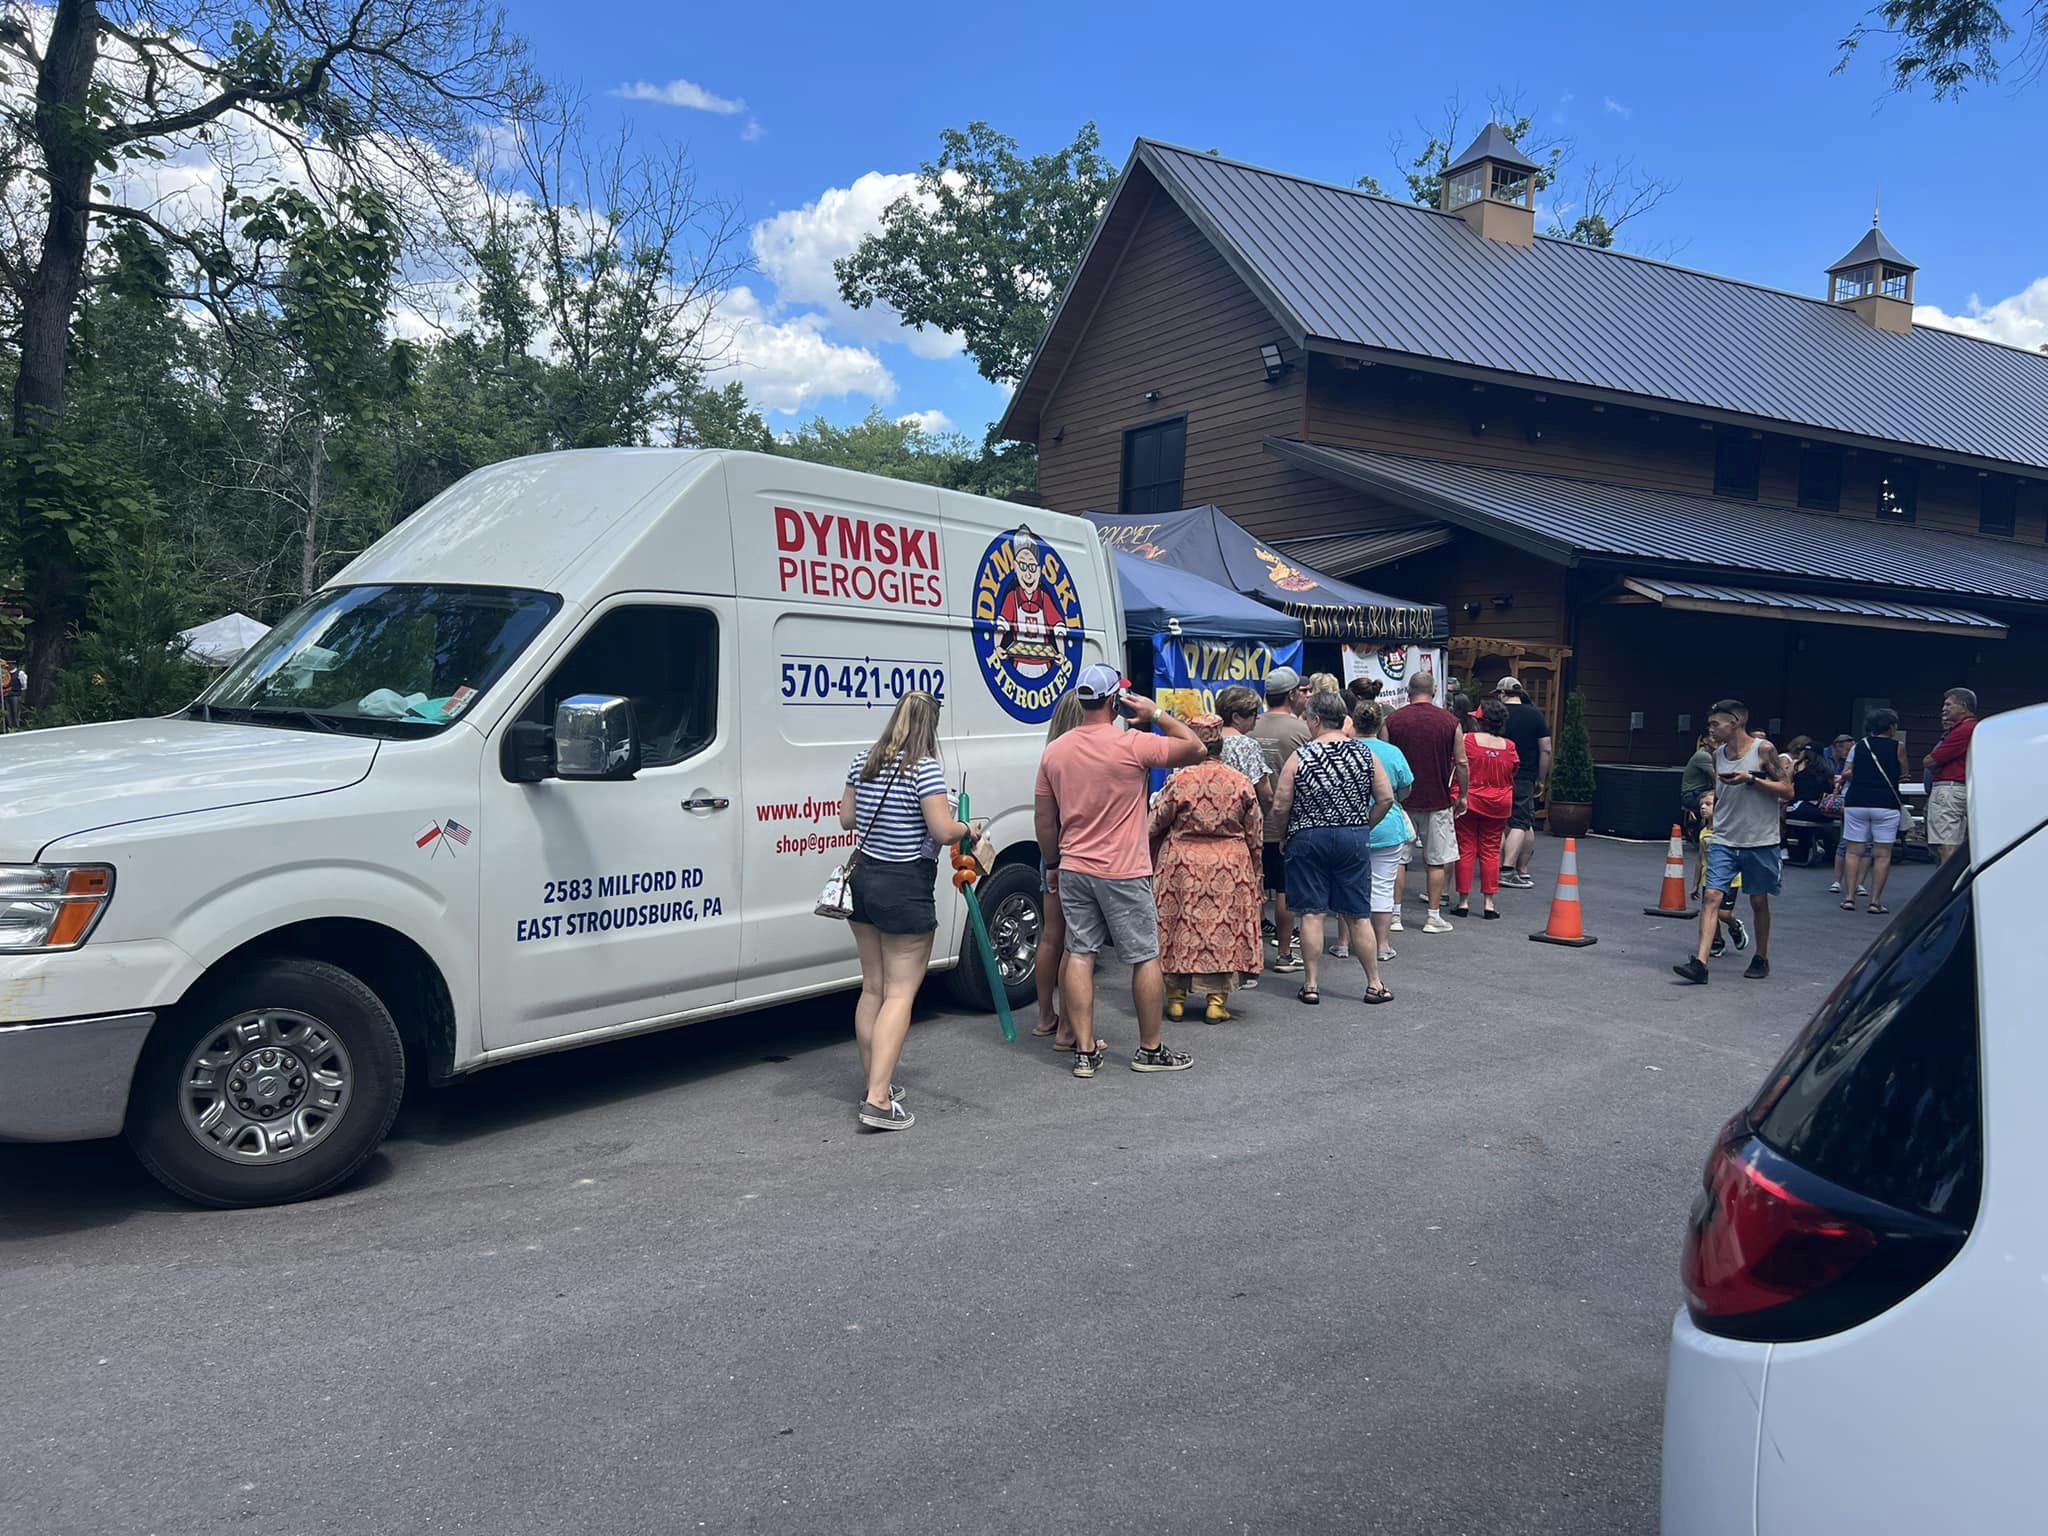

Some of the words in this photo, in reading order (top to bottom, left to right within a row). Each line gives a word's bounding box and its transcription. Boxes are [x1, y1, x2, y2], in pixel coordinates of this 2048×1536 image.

[774, 506, 940, 571] DYMSKI
[778, 557, 943, 608] PIEROGIES
[781, 663, 945, 700] 570-421-0102
[985, 651, 1073, 710] PIEROGIES
[1184, 643, 1272, 681] DYMSKI
[543, 878, 593, 904] 2583
[598, 870, 677, 898] MILFORD
[681, 868, 704, 889] RD
[516, 915, 563, 942] EAST
[566, 899, 698, 936] STROUDSBURG,
[703, 897, 723, 918] PA
